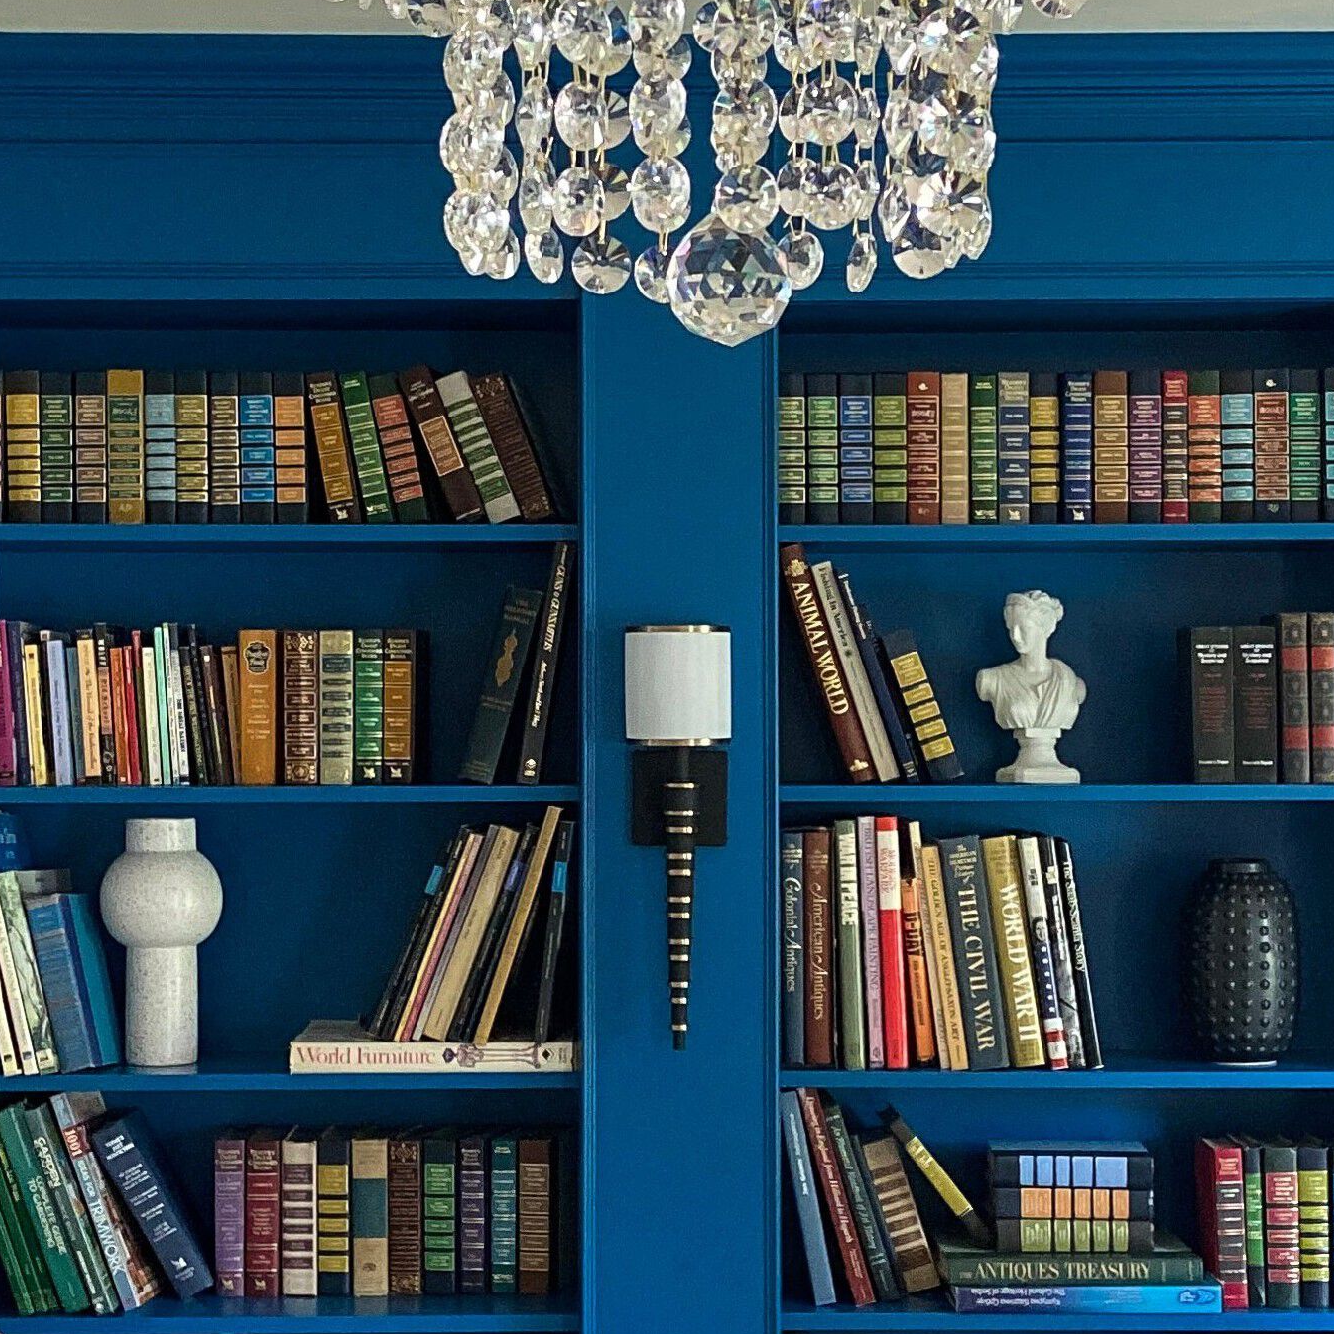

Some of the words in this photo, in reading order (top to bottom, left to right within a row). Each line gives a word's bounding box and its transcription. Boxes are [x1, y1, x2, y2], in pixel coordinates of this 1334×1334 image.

[552, 563, 567, 591] GUNS
[541, 597, 561, 652] GUNSMITHS
[790, 578, 830, 654] ANIMAL
[812, 649, 851, 717] WORLD
[837, 832, 856, 865] WAR
[839, 866, 857, 881] IN
[862, 826, 874, 871] BRITISH
[784, 876, 801, 930] Colonial
[808, 882, 827, 954] American
[839, 882, 858, 926] PEACE
[864, 871, 877, 935] LANDSCAPE
[929, 878, 943, 918] GOLDEN
[955, 883, 981, 932] THE
[998, 882, 1026, 964] WORLD
[935, 919, 945, 937] AGE
[784, 929, 801, 992] Antiques
[867, 936, 880, 990] PAINTING
[962, 933, 990, 998] CIVIL
[1071, 944, 1086, 973] Story
[810, 954, 828, 1020] Antiques
[1010, 968, 1034, 1019] WAR
[949, 1020, 960, 1041] ART
[971, 1000, 997, 1051] WAR
[1017, 1022, 1038, 1043] II
[295, 1046, 351, 1065] World
[356, 1046, 435, 1065] Furniture
[26, 1178, 38, 1193] TO
[35, 1134, 61, 1188] GARDEN
[63, 1127, 82, 1157] 1001
[87, 1197, 125, 1277] TRIMWORK
[974, 1261, 1059, 1280] ANTIQUES
[1064, 1261, 1151, 1280] TREASURY
